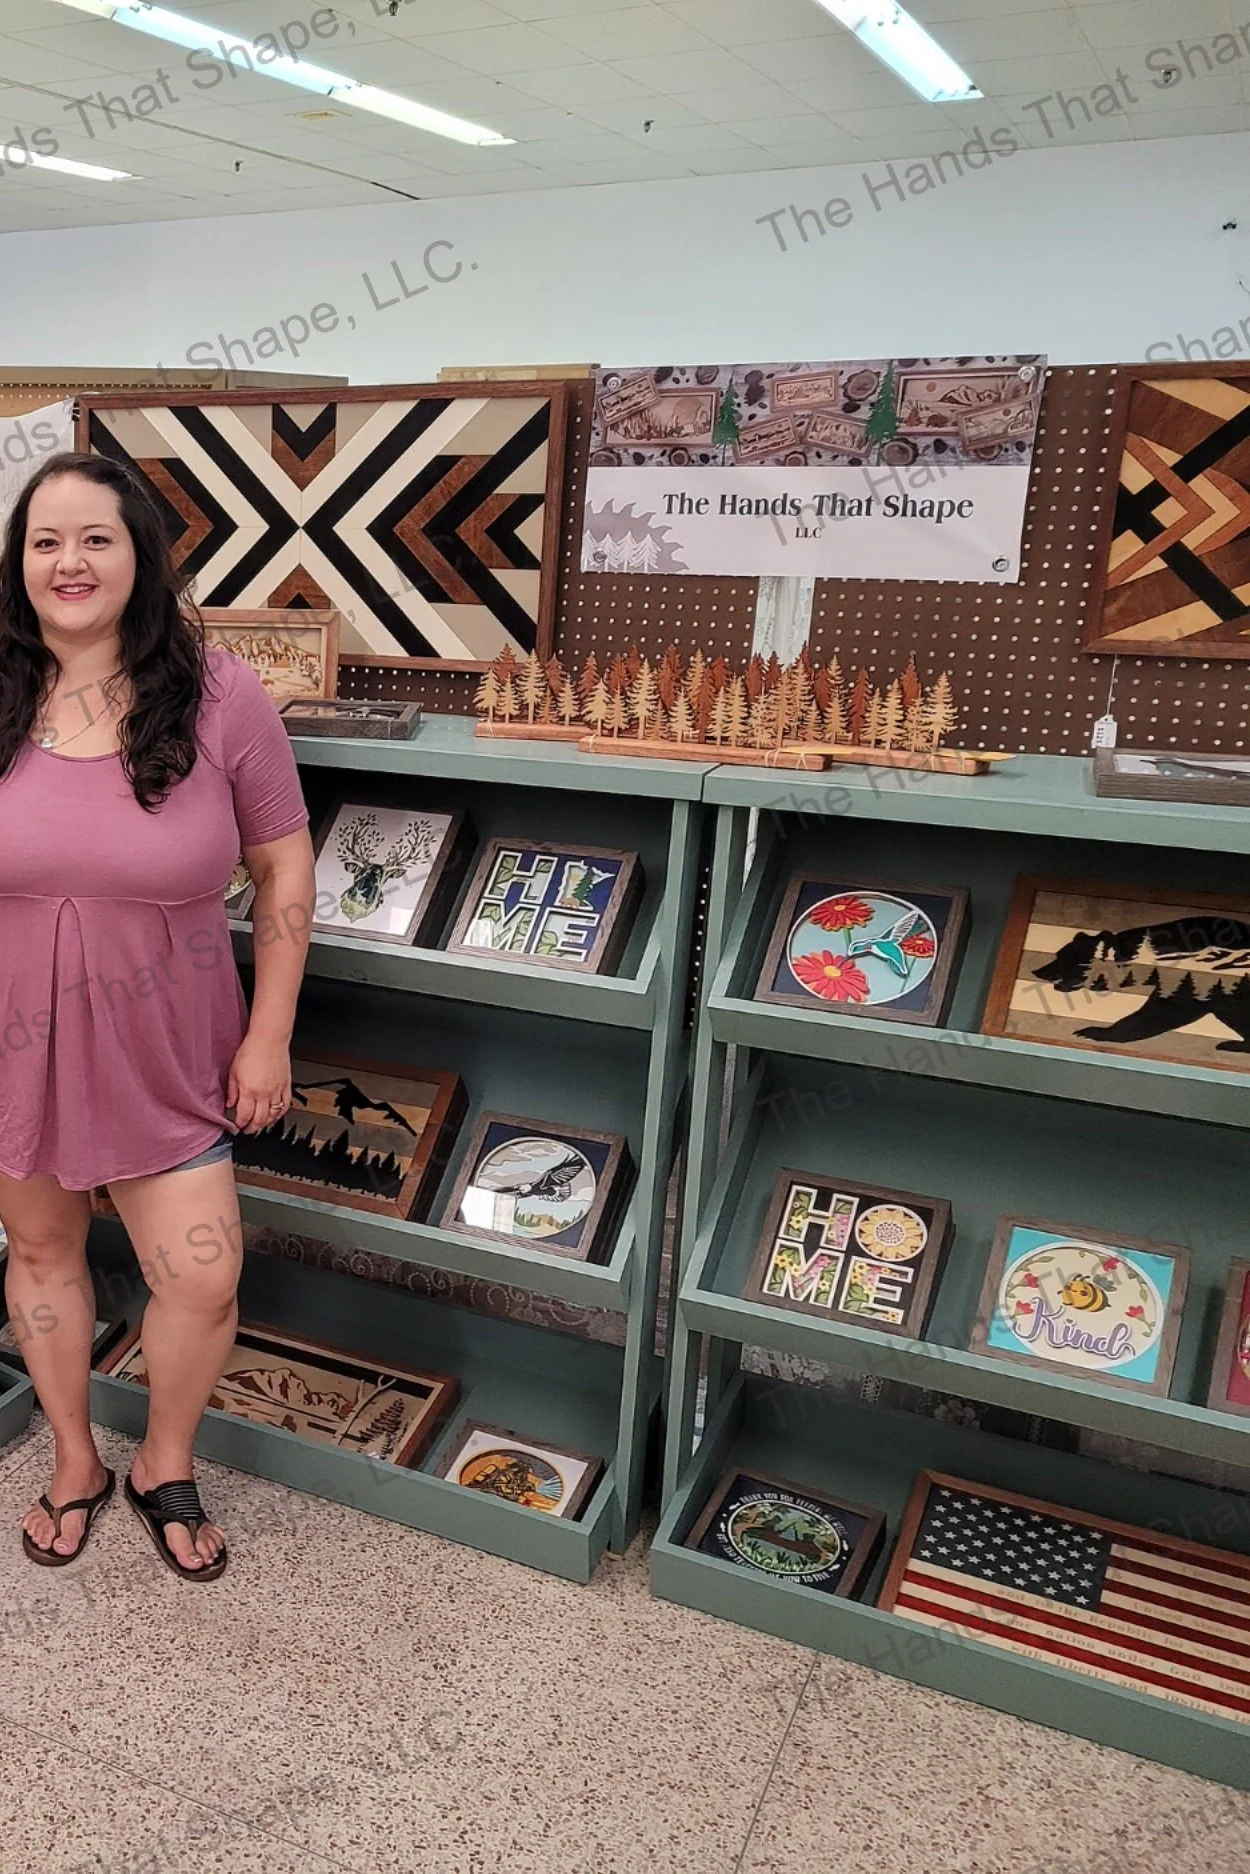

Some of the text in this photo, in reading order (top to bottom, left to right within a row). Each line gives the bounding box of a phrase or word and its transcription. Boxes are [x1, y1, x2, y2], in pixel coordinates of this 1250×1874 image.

[662, 491, 974, 524] The Hands That Shape
[795, 527, 823, 539] LLC
[1013, 1296, 1137, 1360] Kind
